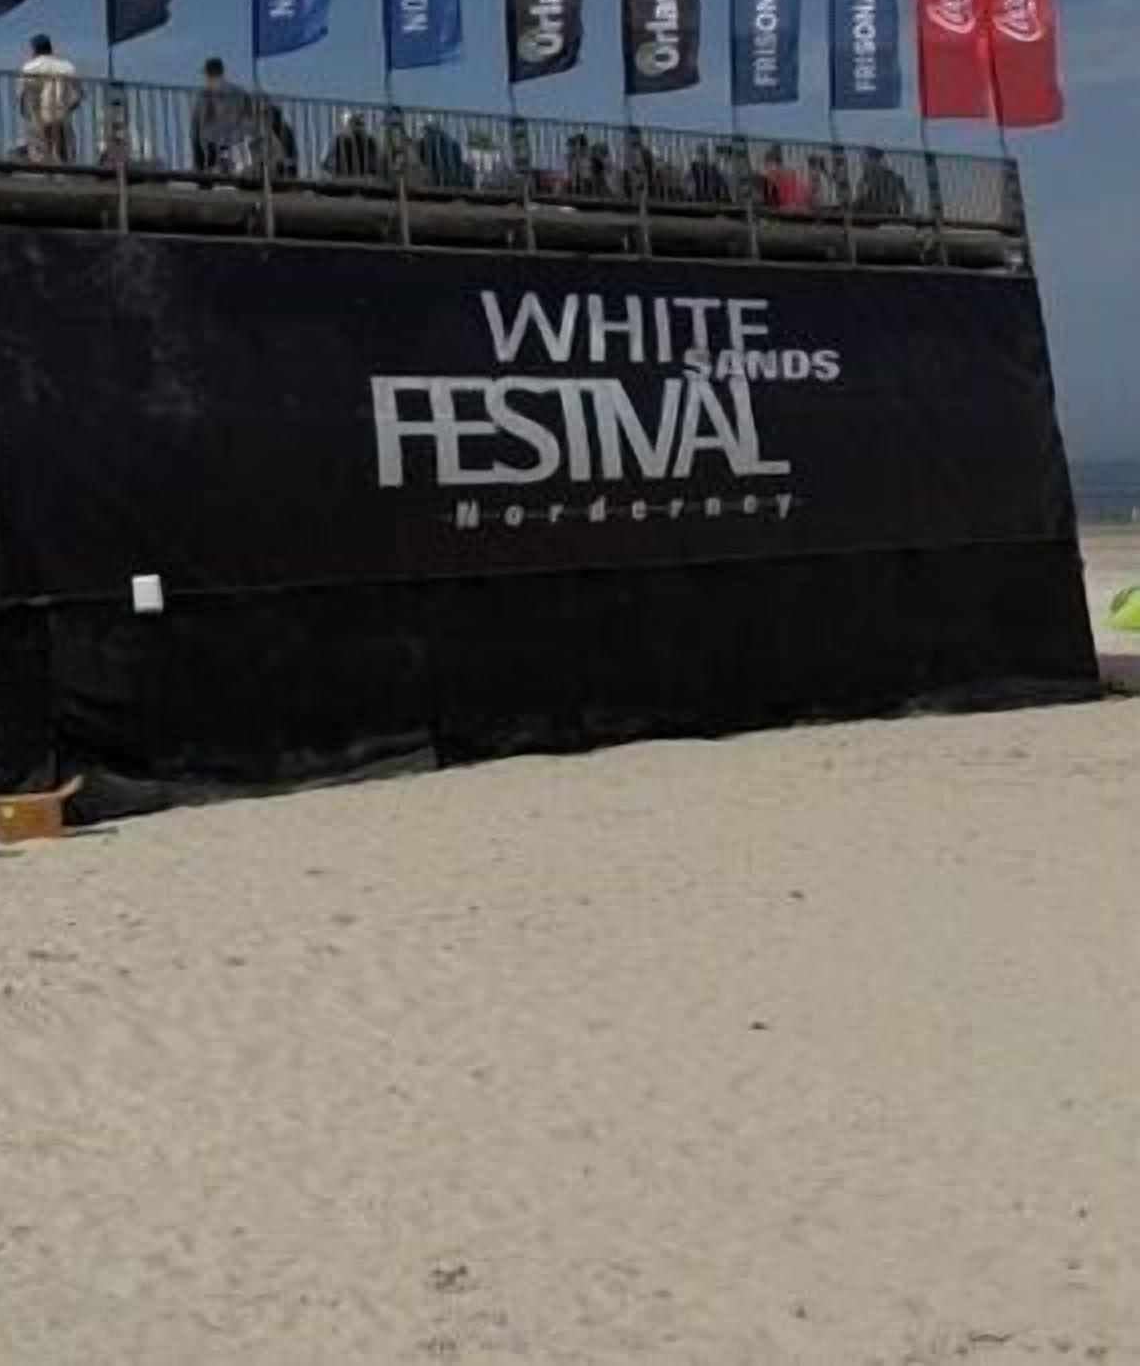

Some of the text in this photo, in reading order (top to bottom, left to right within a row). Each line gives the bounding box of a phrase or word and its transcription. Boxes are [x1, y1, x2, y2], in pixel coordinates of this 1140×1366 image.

[480, 289, 769, 362] WHITE
[682, 349, 842, 382] SANDS
[371, 372, 792, 487] FESTIVAL
